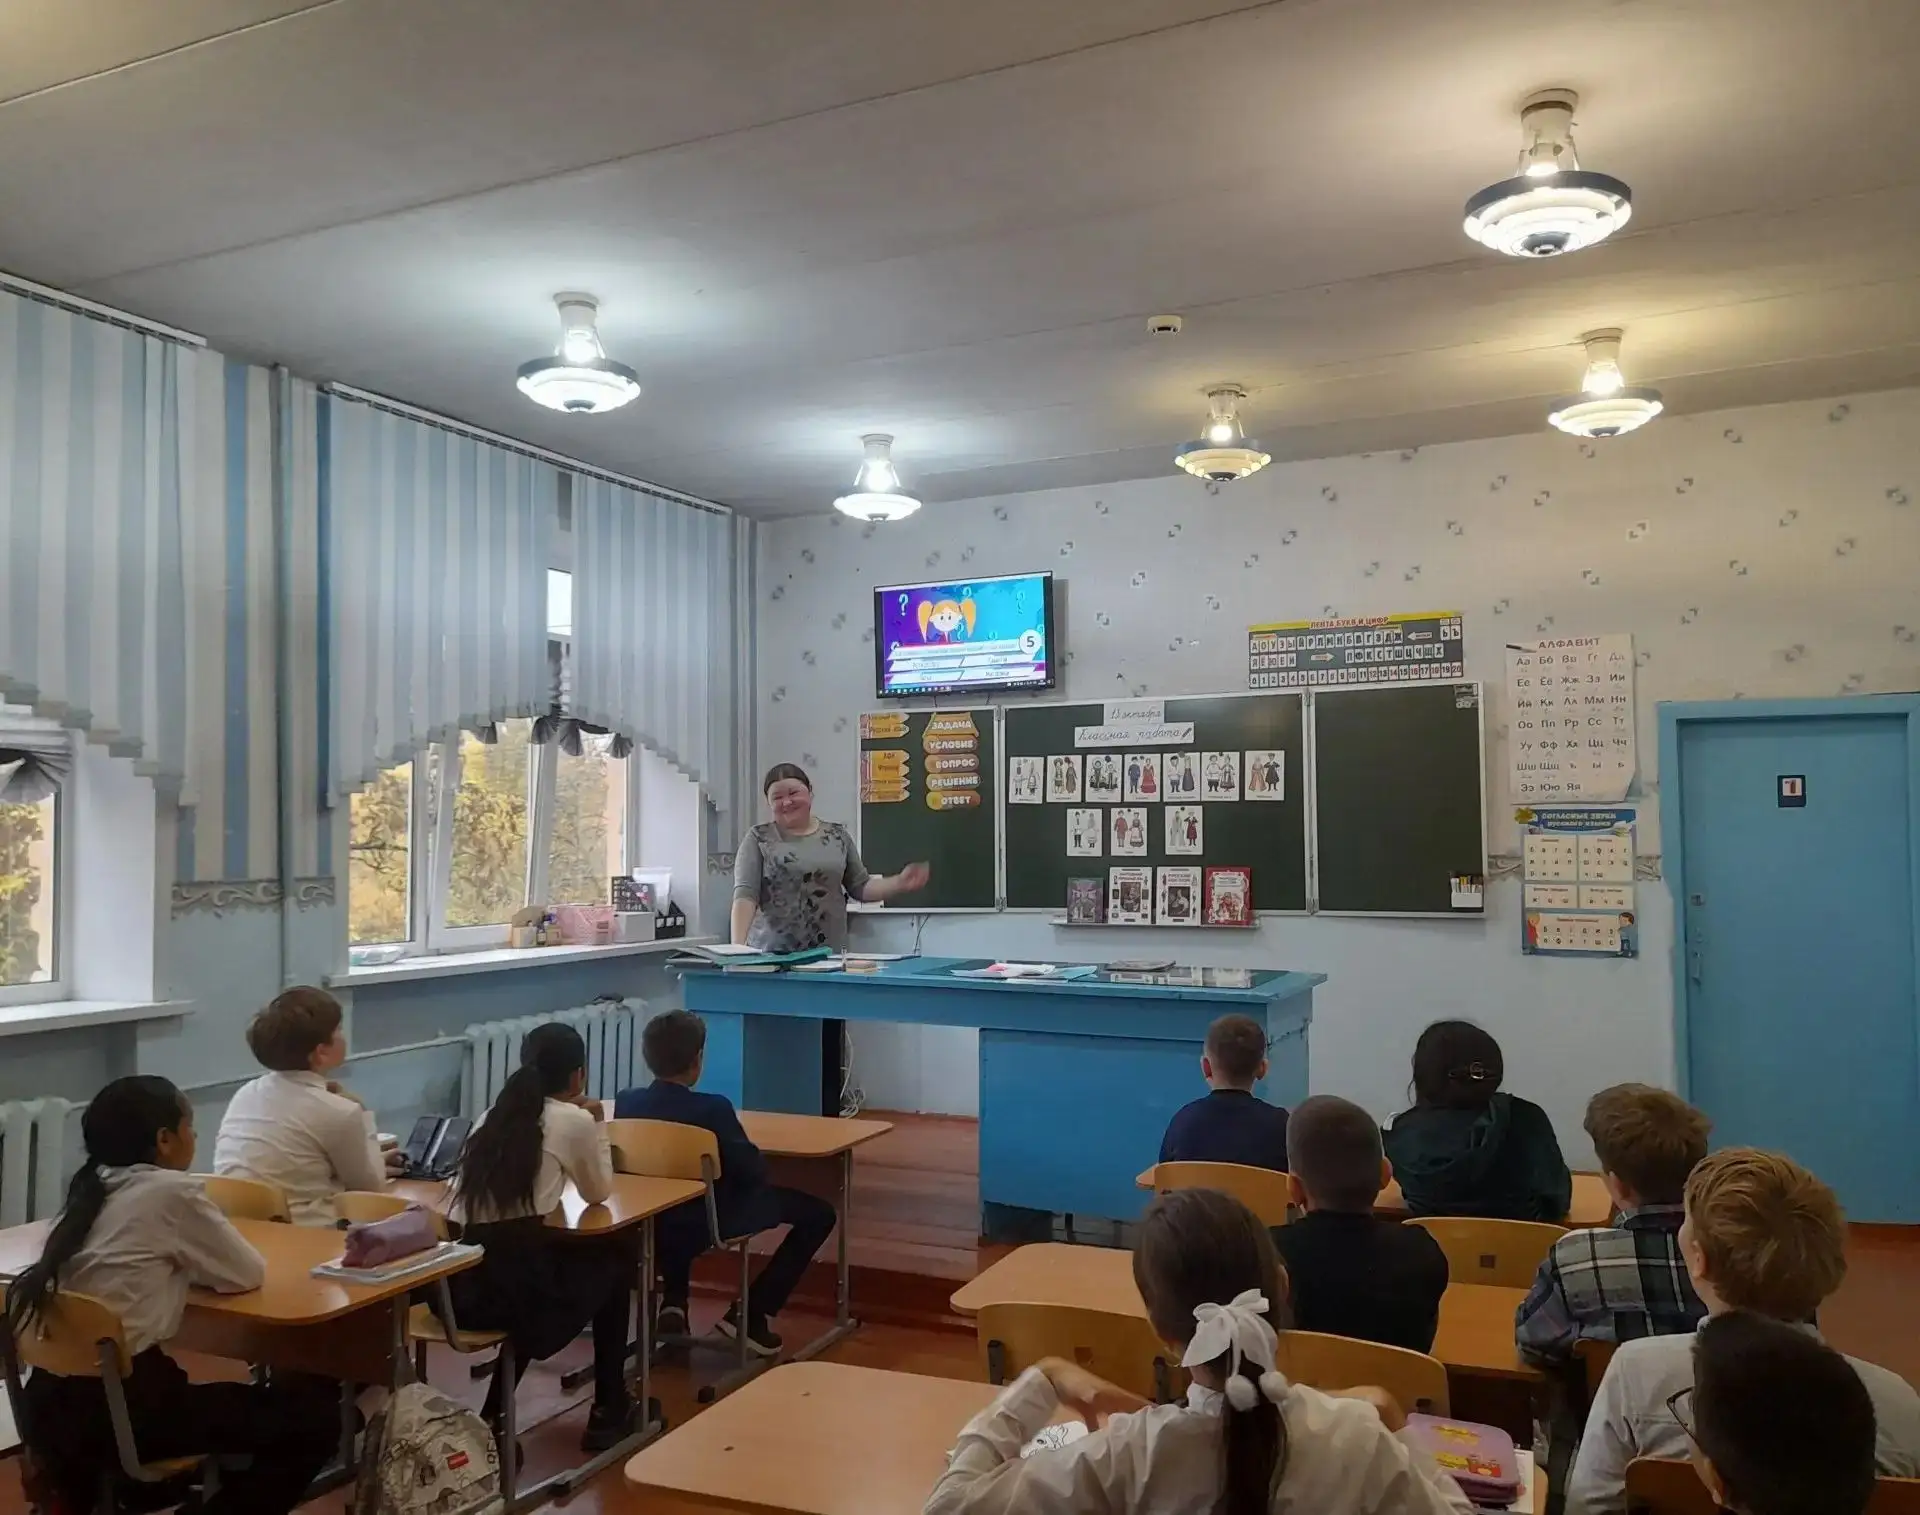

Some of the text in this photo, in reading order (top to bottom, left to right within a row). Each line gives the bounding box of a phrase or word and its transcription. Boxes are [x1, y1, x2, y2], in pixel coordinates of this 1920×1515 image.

[1366, 617, 1389, 626] ЦИФР
[1027, 636, 1034, 647] 5
[1539, 638, 1601, 649] АЛФАВИТ
[932, 721, 971, 730] ЗАДАЧА
[1518, 716, 1624, 729] Оо Пп Рр Сс Тт
[929, 740, 973, 749] УСЛОВИЕ
[1520, 738, 1627, 751] Уу Фф Хх Цц Чч
[935, 759, 975, 768] ВОПРОС
[932, 776, 978, 787] РЕШЕНИЕ
[1521, 782, 1580, 792] Ээ Юю Яя
[941, 796, 971, 805] ОТВЕТ
